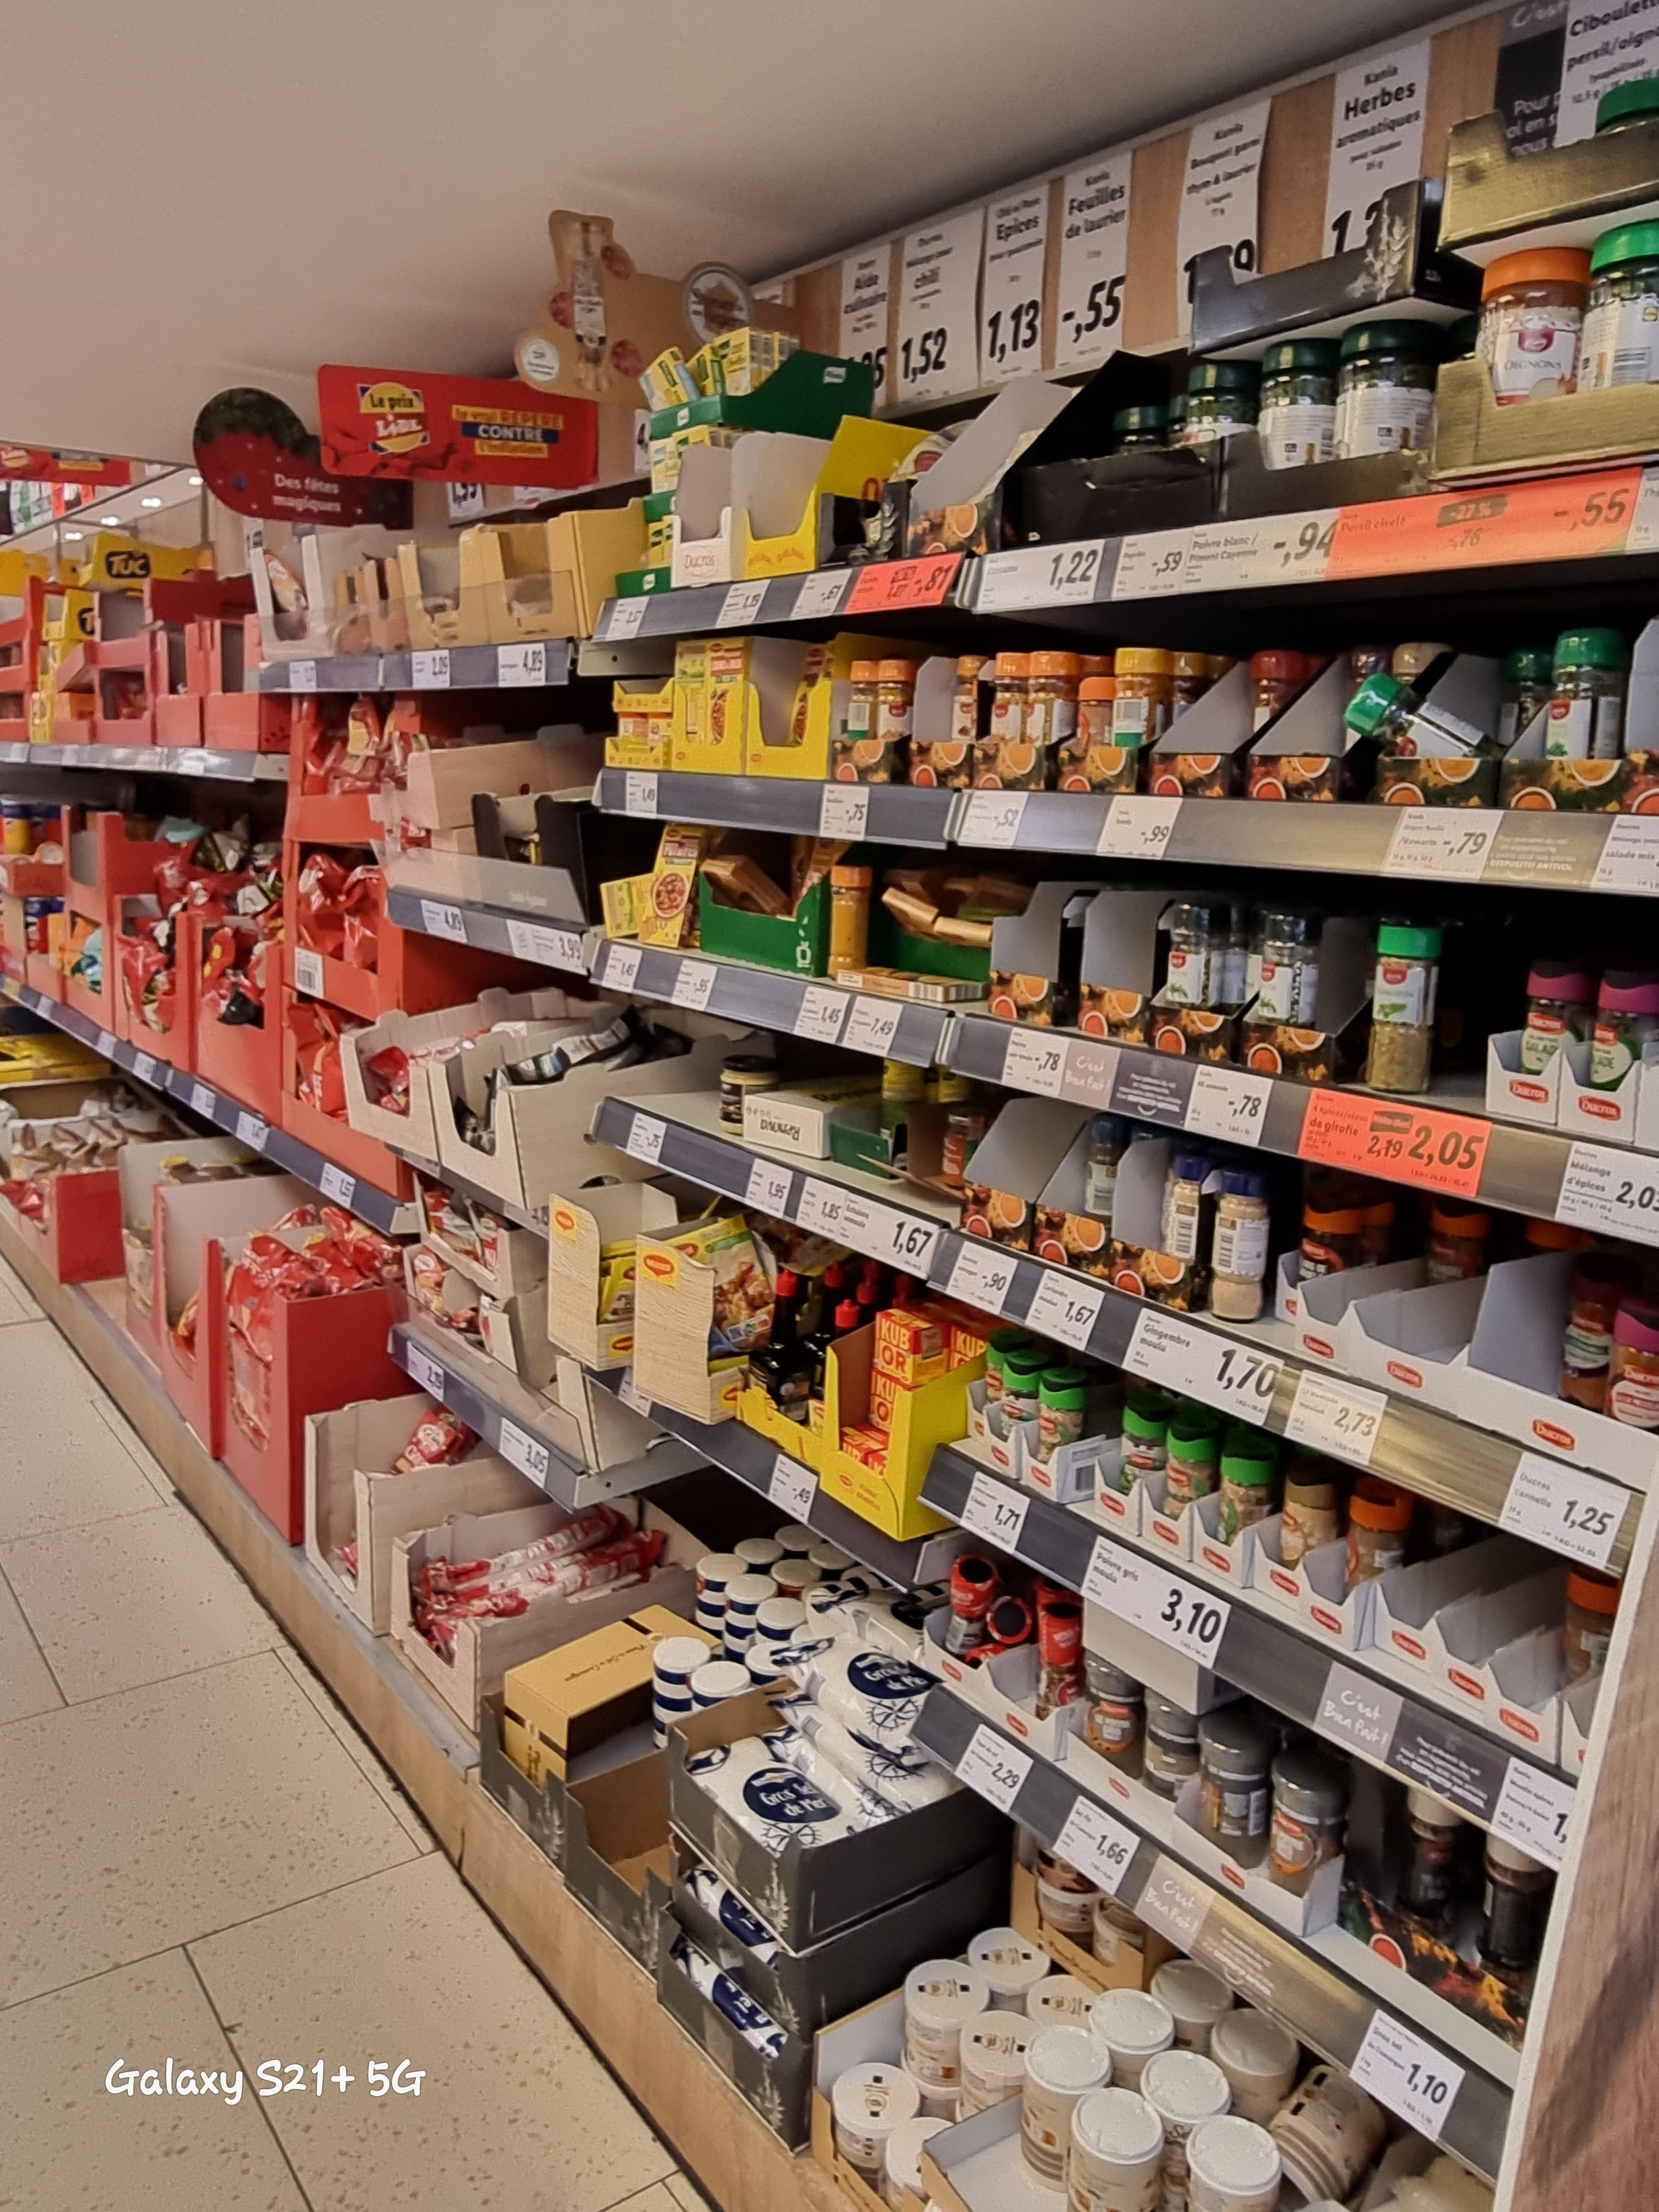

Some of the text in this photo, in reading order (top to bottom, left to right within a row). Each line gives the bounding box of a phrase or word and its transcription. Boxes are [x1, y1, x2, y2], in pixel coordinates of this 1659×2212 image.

[1345, 82, 1417, 120] Herbes
[1336, 111, 1420, 148] aromatiques
[1069, 185, 1125, 215] Feuilles
[1063, 275, 1126, 343] -,55
[988, 300, 1040, 363] 1,13
[902, 328, 947, 383] 1,52
[369, 392, 415, 410] Le prix
[478, 425, 544, 441] CONTRE
[275, 473, 301, 489] Des
[1554, 489, 1629, 532] -,55
[1050, 549, 1099, 591] 1,22
[1153, 551, 1183, 576] -,59
[1443, 831, 1487, 857] -,79
[1035, 1052, 1061, 1071] -,78
[1228, 1093, 1261, 1118] -,78
[1582, 1101, 1617, 1116] Ducros
[1367, 1125, 1485, 1170] 2,19 2,05
[1571, 1161, 1611, 1178] Mélange
[1566, 1176, 1606, 1193] d'épices
[1616, 1181, 1659, 1212] 2,0
[893, 1221, 933, 1257] 1,67
[981, 1273, 1007, 1291] -,90
[1065, 1301, 1096, 1325] 1,67
[881, 1318, 910, 1350] KUB
[1143, 1323, 1191, 1348] Gingembre
[882, 1344, 907, 1369] OR
[1217, 1348, 1280, 1398] 1,70
[1334, 1406, 1377, 1437] 2,73
[1537, 1424, 1572, 1446] Ducros
[994, 1504, 1022, 1531] 1,71
[1563, 1500, 1615, 1536] 1,25
[1096, 1551, 1122, 1573] Poivre
[1161, 1588, 1222, 1644] 3,10
[992, 1762, 1020, 1788] 2,29
[760, 1788, 796, 1806] Gros
[783, 1803, 804, 1816] de
[1097, 1835, 1128, 1865] 1,66
[1407, 2063, 1448, 2104] 1,10
